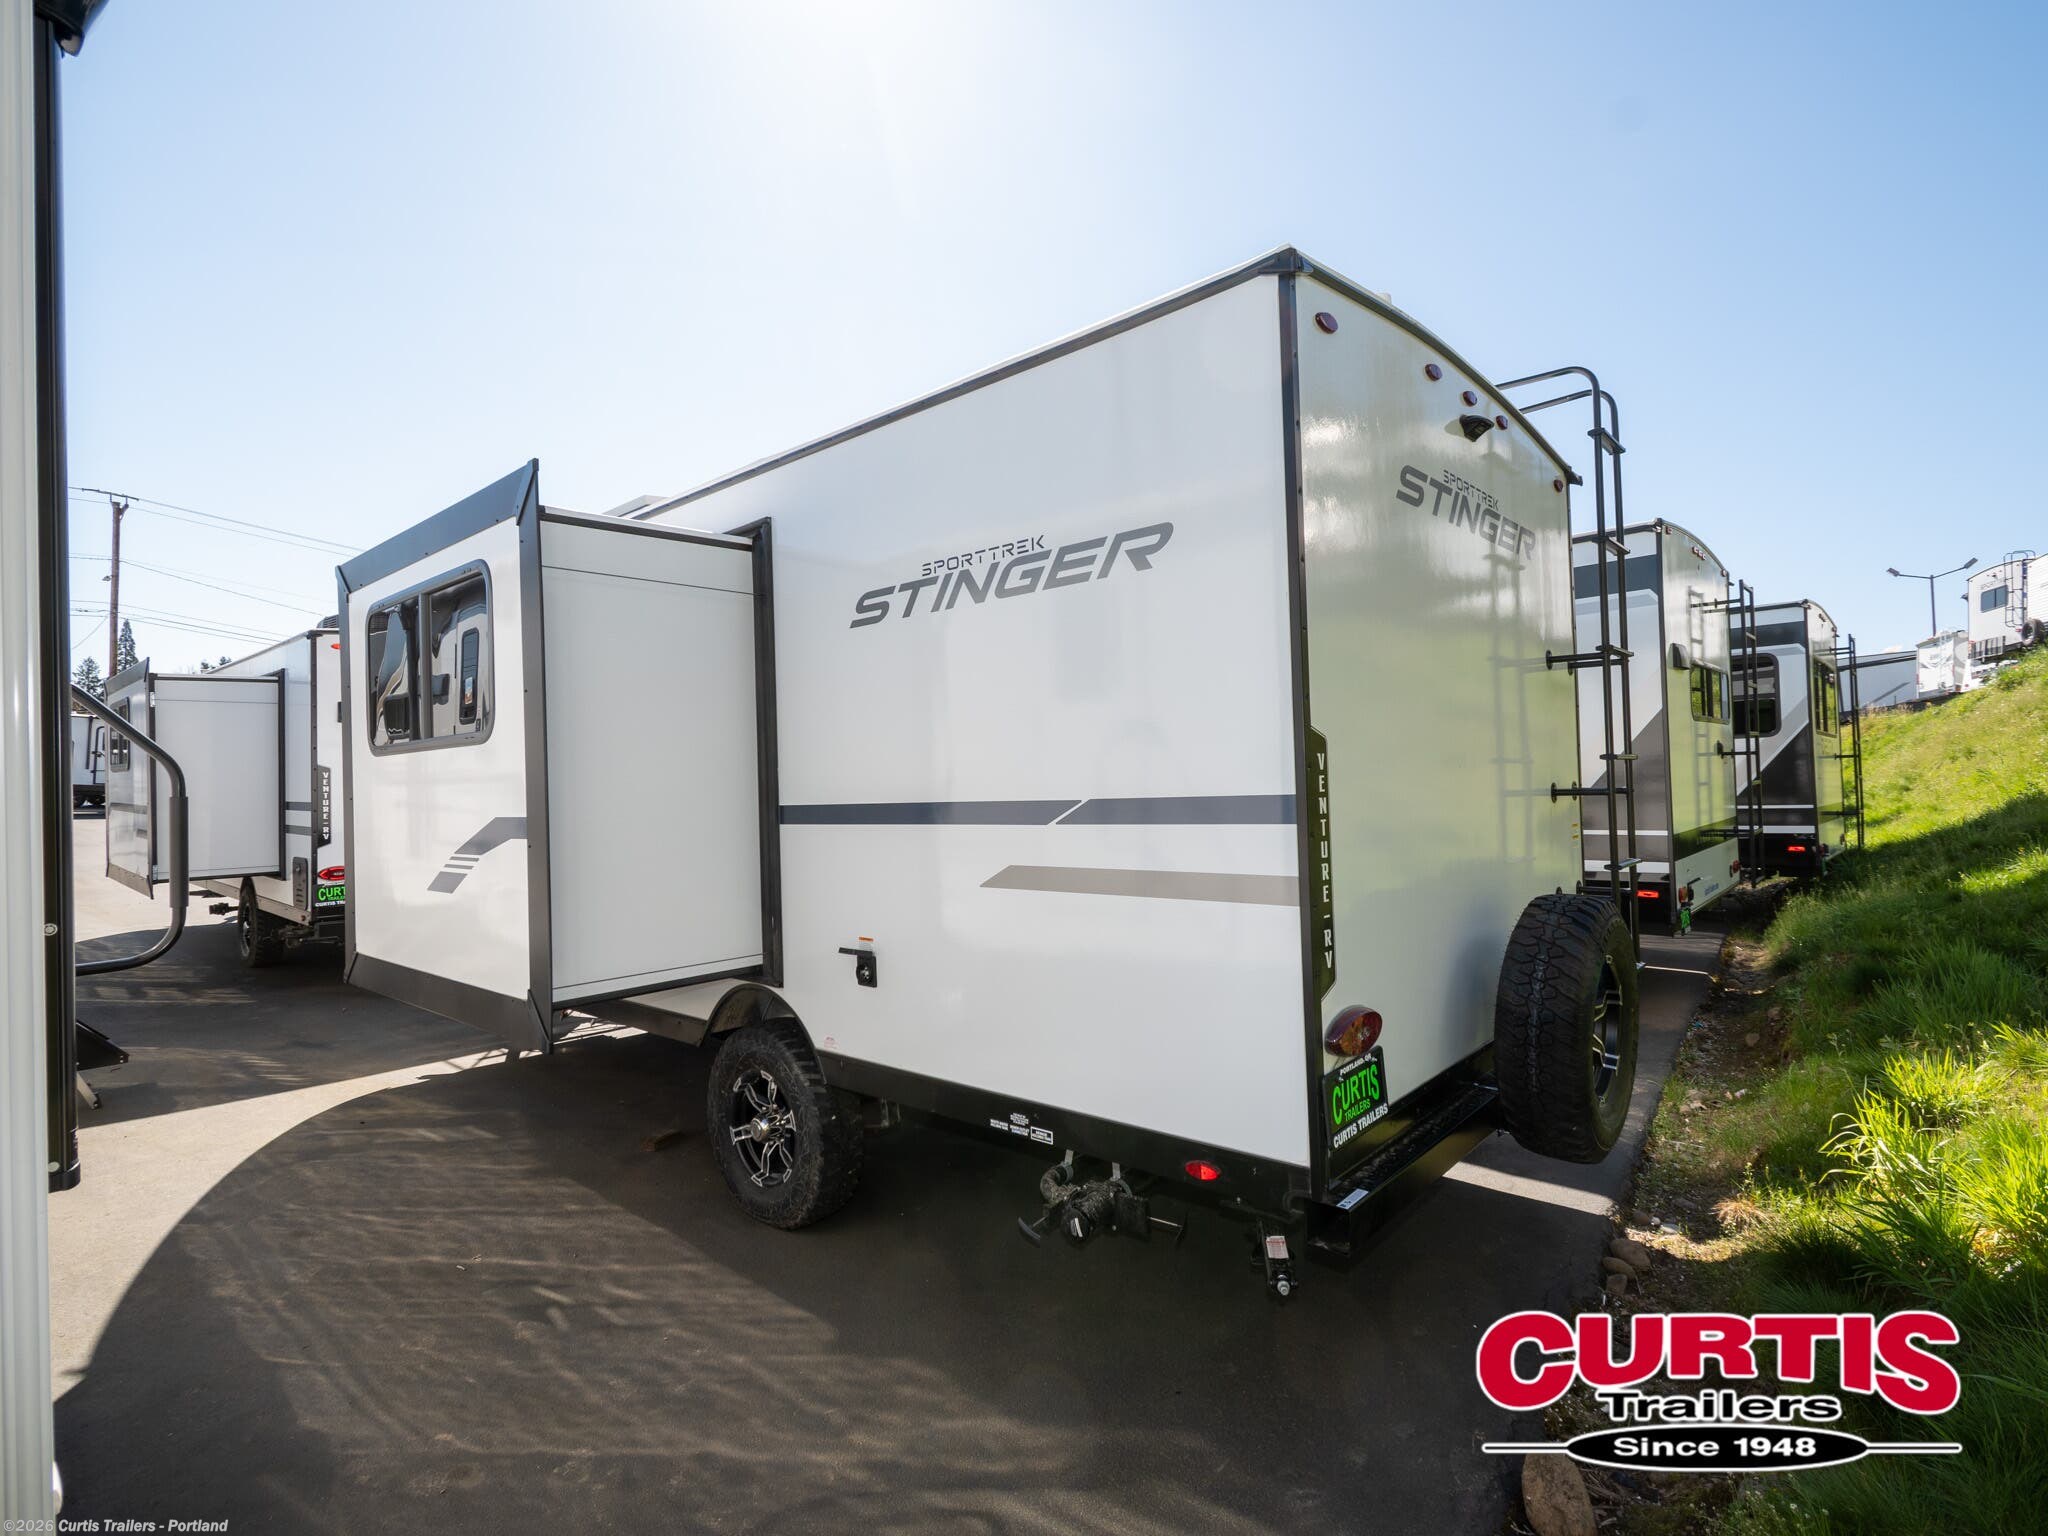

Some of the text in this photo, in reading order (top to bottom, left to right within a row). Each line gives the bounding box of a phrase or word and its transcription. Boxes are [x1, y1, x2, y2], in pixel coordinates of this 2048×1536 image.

[1396, 464, 1536, 560] STINGER
[1443, 469, 1499, 511] SPORTTREK
[849, 521, 1175, 629] STINGER
[922, 534, 1045, 577] SPORTTREK
[1332, 1064, 1380, 1124] CURTIS
[1344, 1099, 1371, 1121] TRAILERS
[1333, 1102, 1388, 1149] CURTIS TRAILERS
